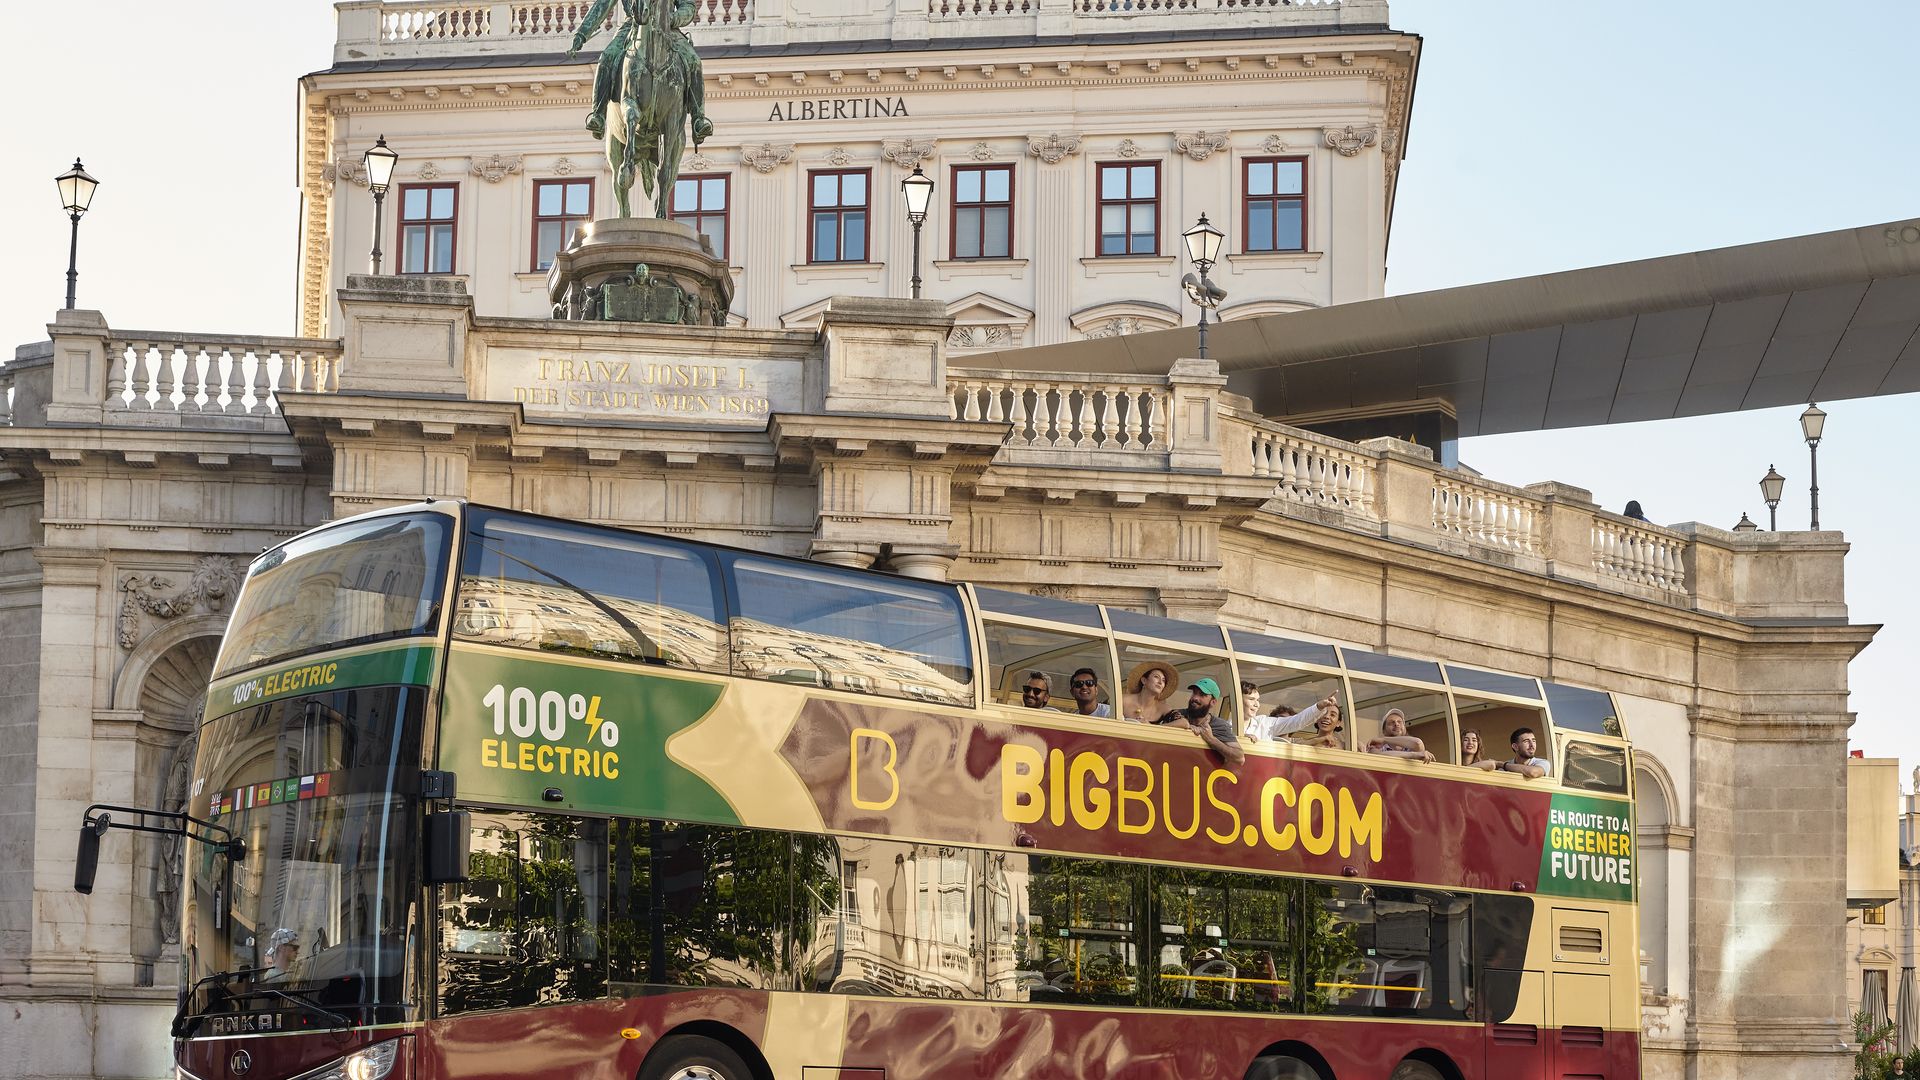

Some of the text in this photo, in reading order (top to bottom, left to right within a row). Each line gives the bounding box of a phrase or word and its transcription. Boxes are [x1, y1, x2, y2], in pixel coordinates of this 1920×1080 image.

[768, 96, 910, 122] ALBERTINA
[537, 357, 753, 389] FRANZ JOSEF I.
[513, 386, 770, 415] DER STADT WIEN 1869
[232, 662, 337, 705] 100% ELECTRIC
[482, 684, 619, 748] 100%
[481, 738, 619, 780] ELECTRIC
[850, 728, 899, 811] B
[1001, 743, 1383, 863] BIGBUS.COM
[1550, 809, 1630, 833] EN ROUTE TO A
[1550, 826, 1631, 857] GREENER
[1551, 851, 1631, 885] FUTURE
[211, 1013, 282, 1034] ANKAI
